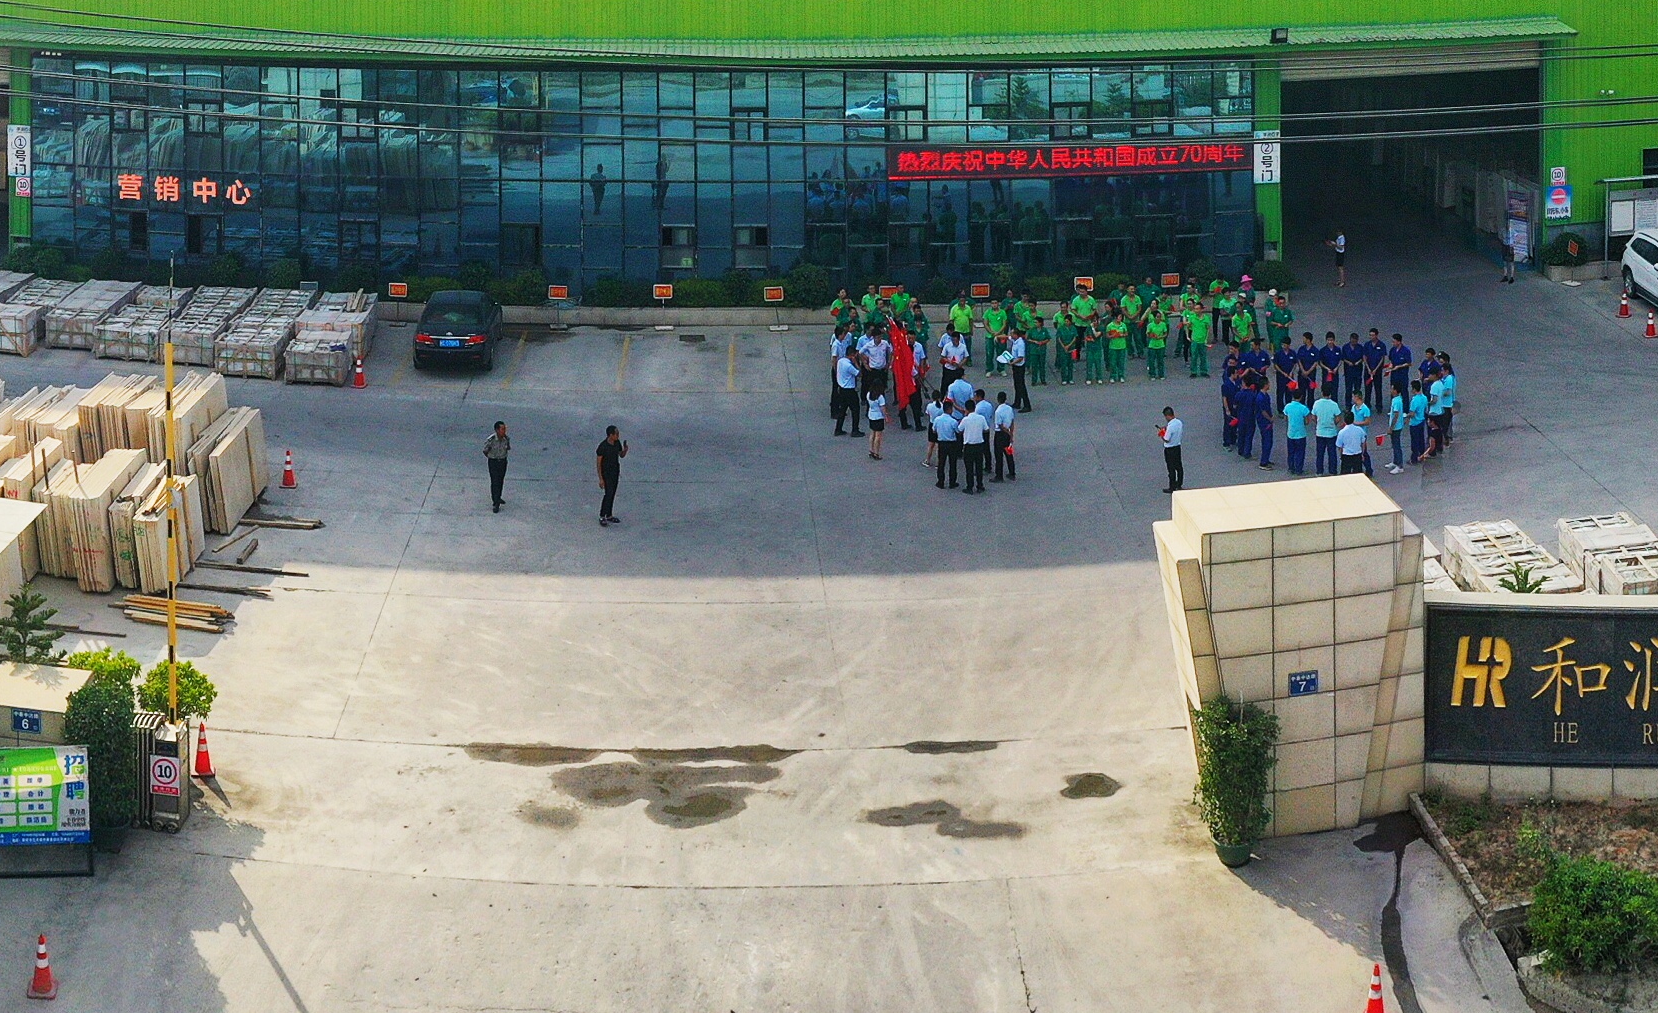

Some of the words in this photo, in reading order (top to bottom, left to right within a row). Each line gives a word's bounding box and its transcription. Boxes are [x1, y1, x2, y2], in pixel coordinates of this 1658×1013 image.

[896, 144, 1245, 173] 热烈庆祝中华人民共和国成立70周年
[116, 173, 252, 205] 营销中心
[1298, 681, 1307, 692] 7
[21, 718, 29, 730] 6
[1553, 721, 1579, 744] HE
[157, 764, 173, 779] 10
